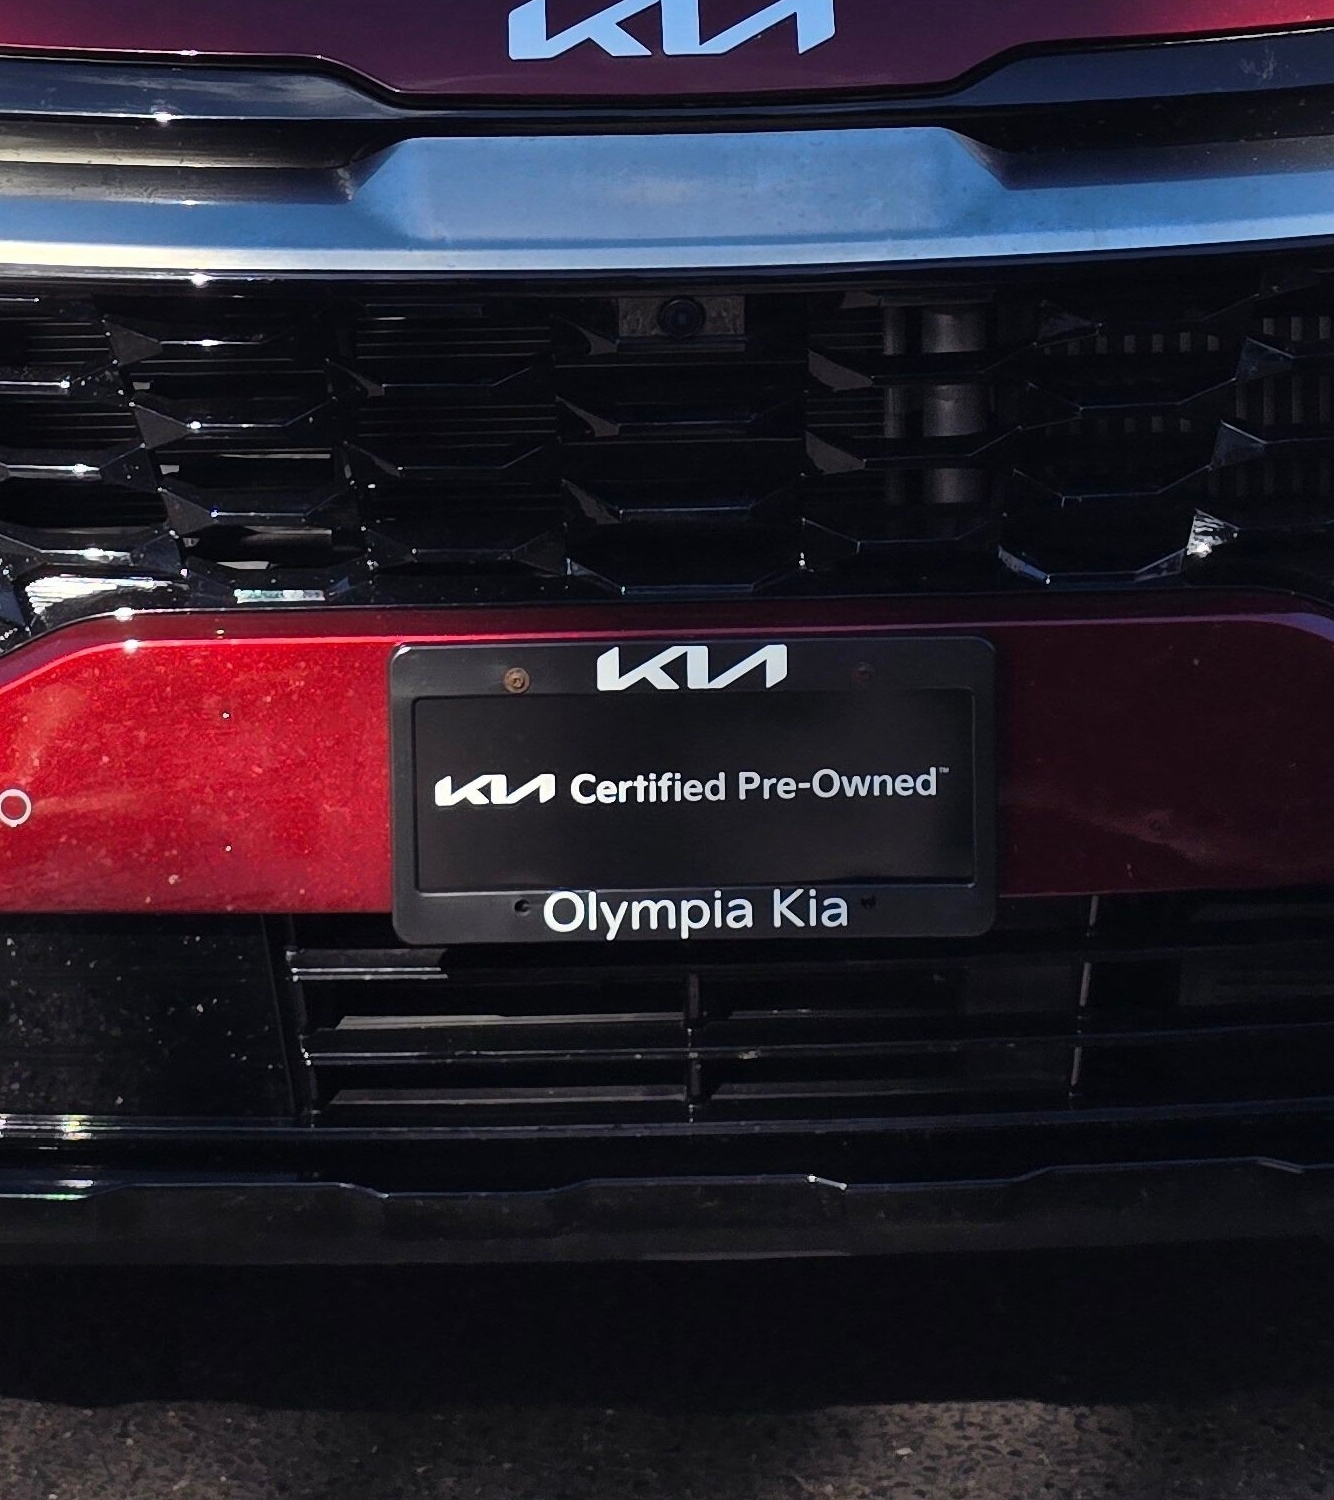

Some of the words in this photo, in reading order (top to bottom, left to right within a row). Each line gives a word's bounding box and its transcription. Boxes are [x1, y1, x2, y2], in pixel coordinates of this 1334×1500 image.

[597, 644, 788, 691] KIA
[435, 773, 556, 806] KIA
[570, 771, 726, 804] Certified
[543, 889, 754, 941] Olympia
[773, 888, 848, 928] Kia
